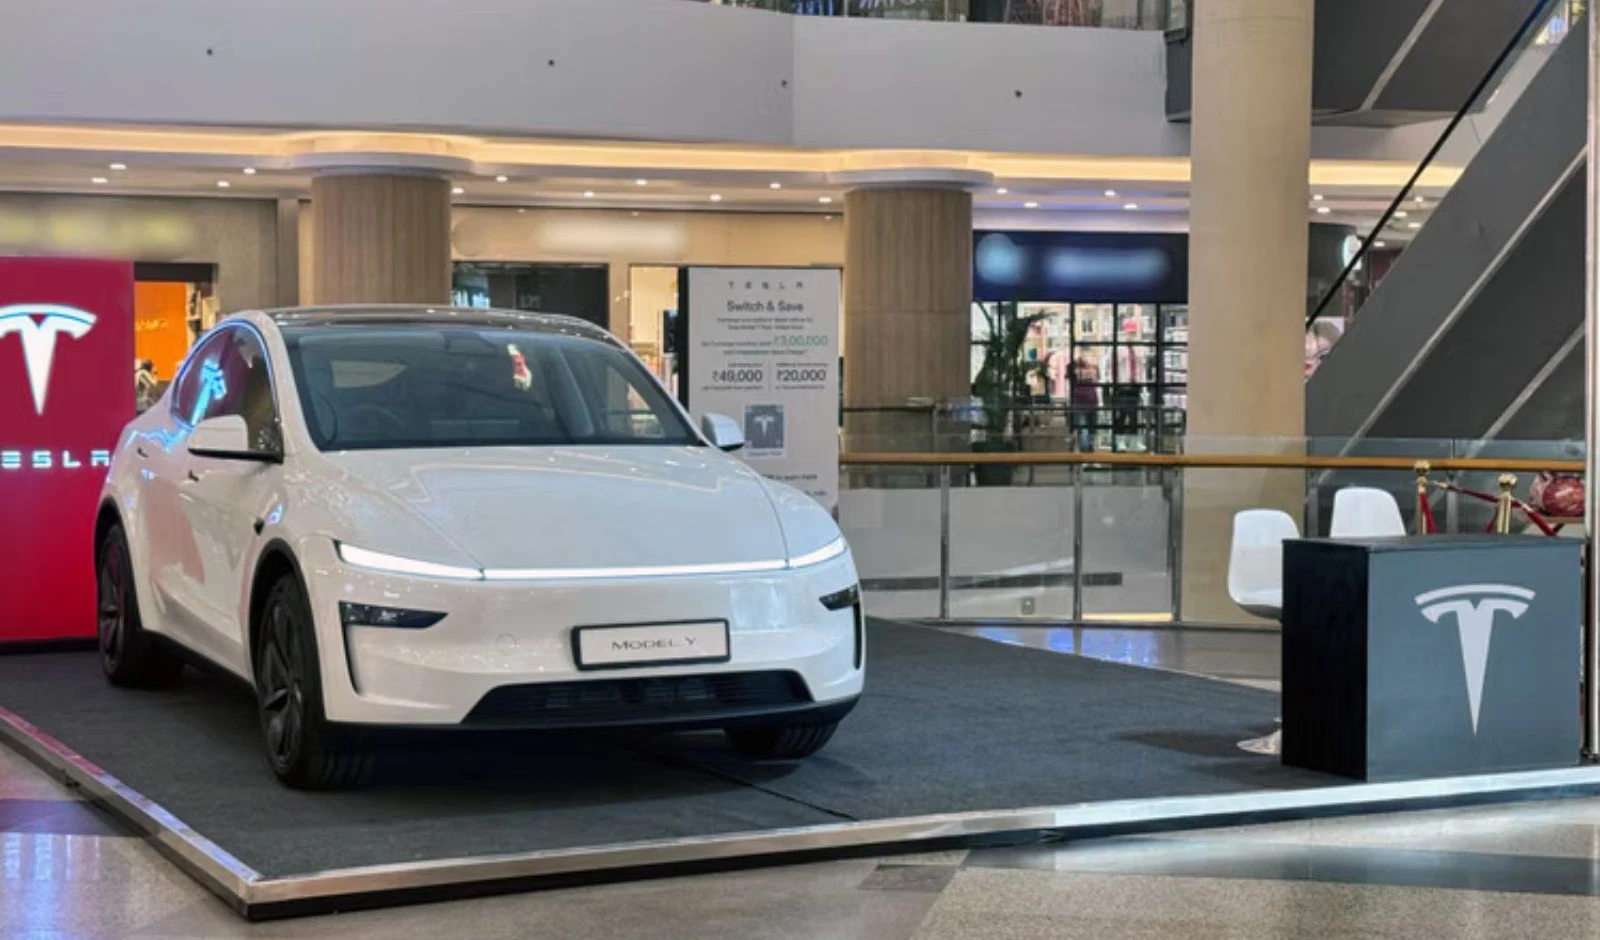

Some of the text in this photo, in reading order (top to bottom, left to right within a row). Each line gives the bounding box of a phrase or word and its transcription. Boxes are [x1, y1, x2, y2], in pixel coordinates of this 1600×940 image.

[727, 300, 804, 312] Switch & Save
[0, 449, 110, 469] ESLA
[684, 636, 697, 646] Y
